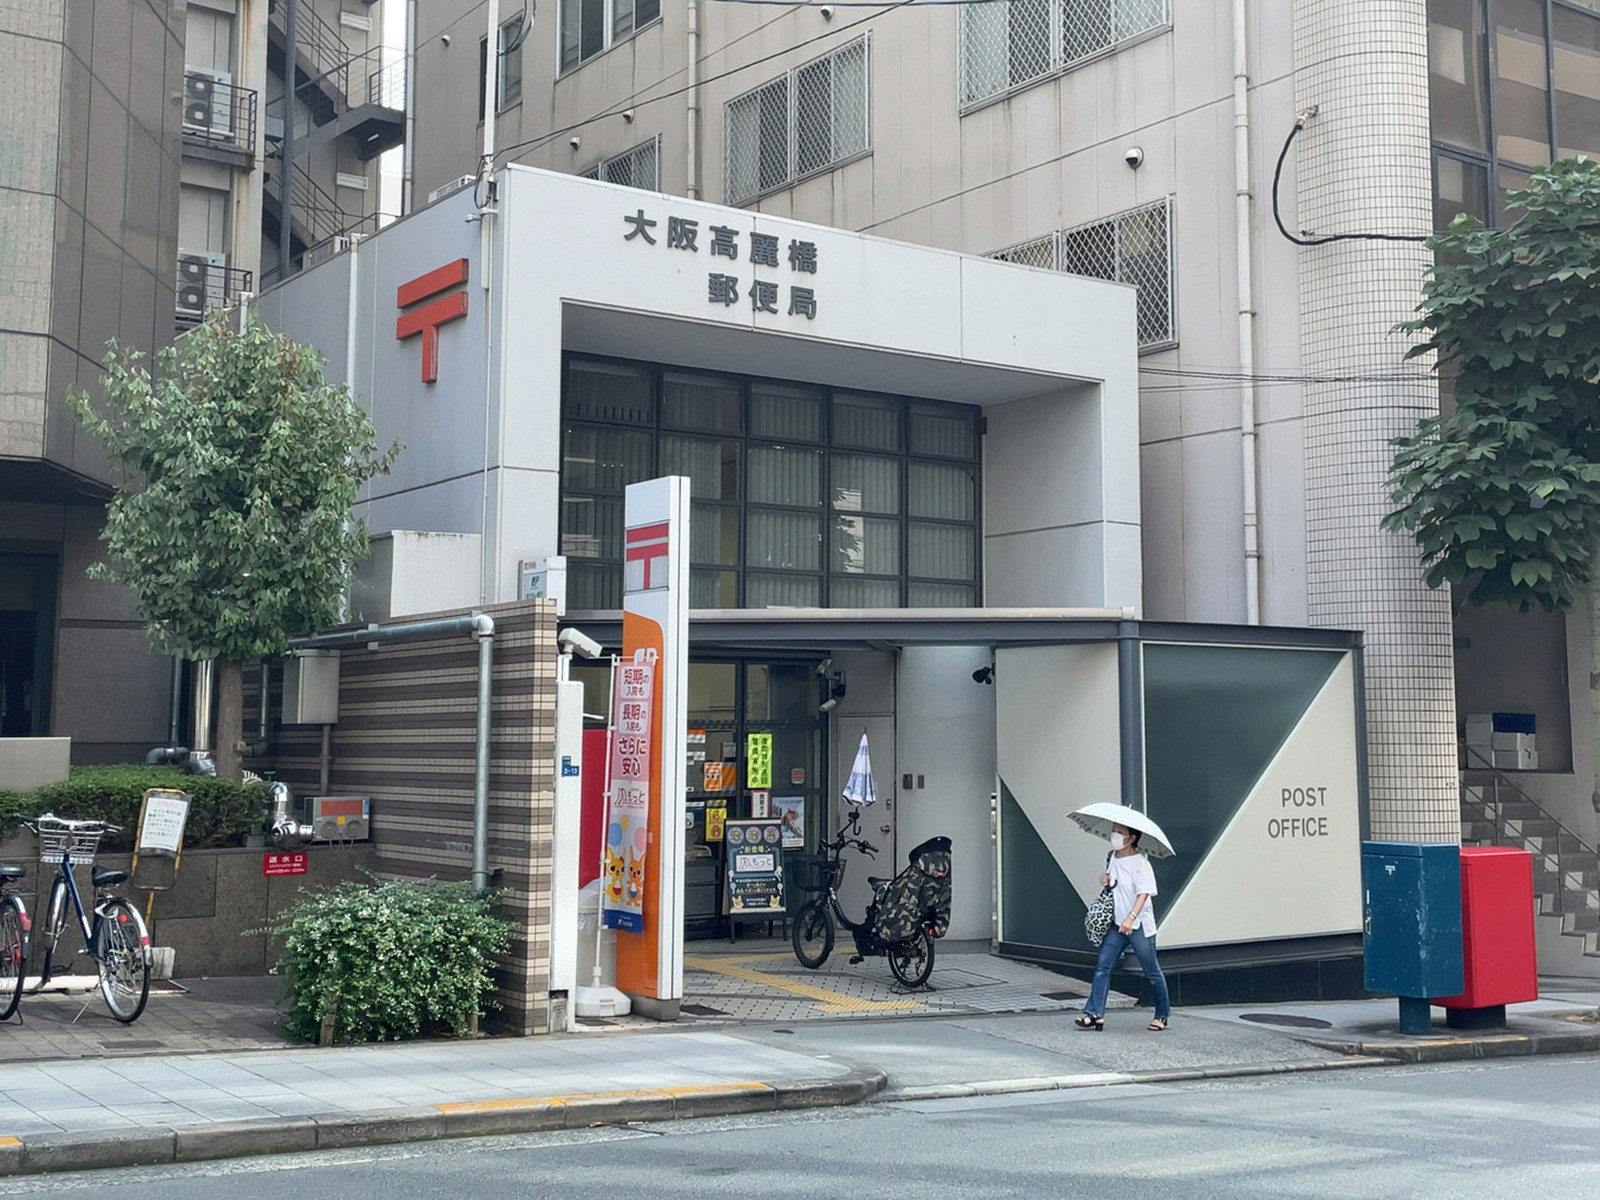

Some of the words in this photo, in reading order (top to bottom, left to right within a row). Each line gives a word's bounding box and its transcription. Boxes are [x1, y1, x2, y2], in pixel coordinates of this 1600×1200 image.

[624, 209, 818, 274] 大阪高麗橋
[708, 272, 818, 320] 郵便局
[624, 669, 650, 685] 短期の
[623, 704, 647, 720] 長期の
[619, 738, 646, 755] さらに
[622, 758, 641, 776] 安心
[1282, 787, 1327, 807] POST
[1268, 817, 1328, 838] OFFICE
[269, 854, 303, 863] 送水口
